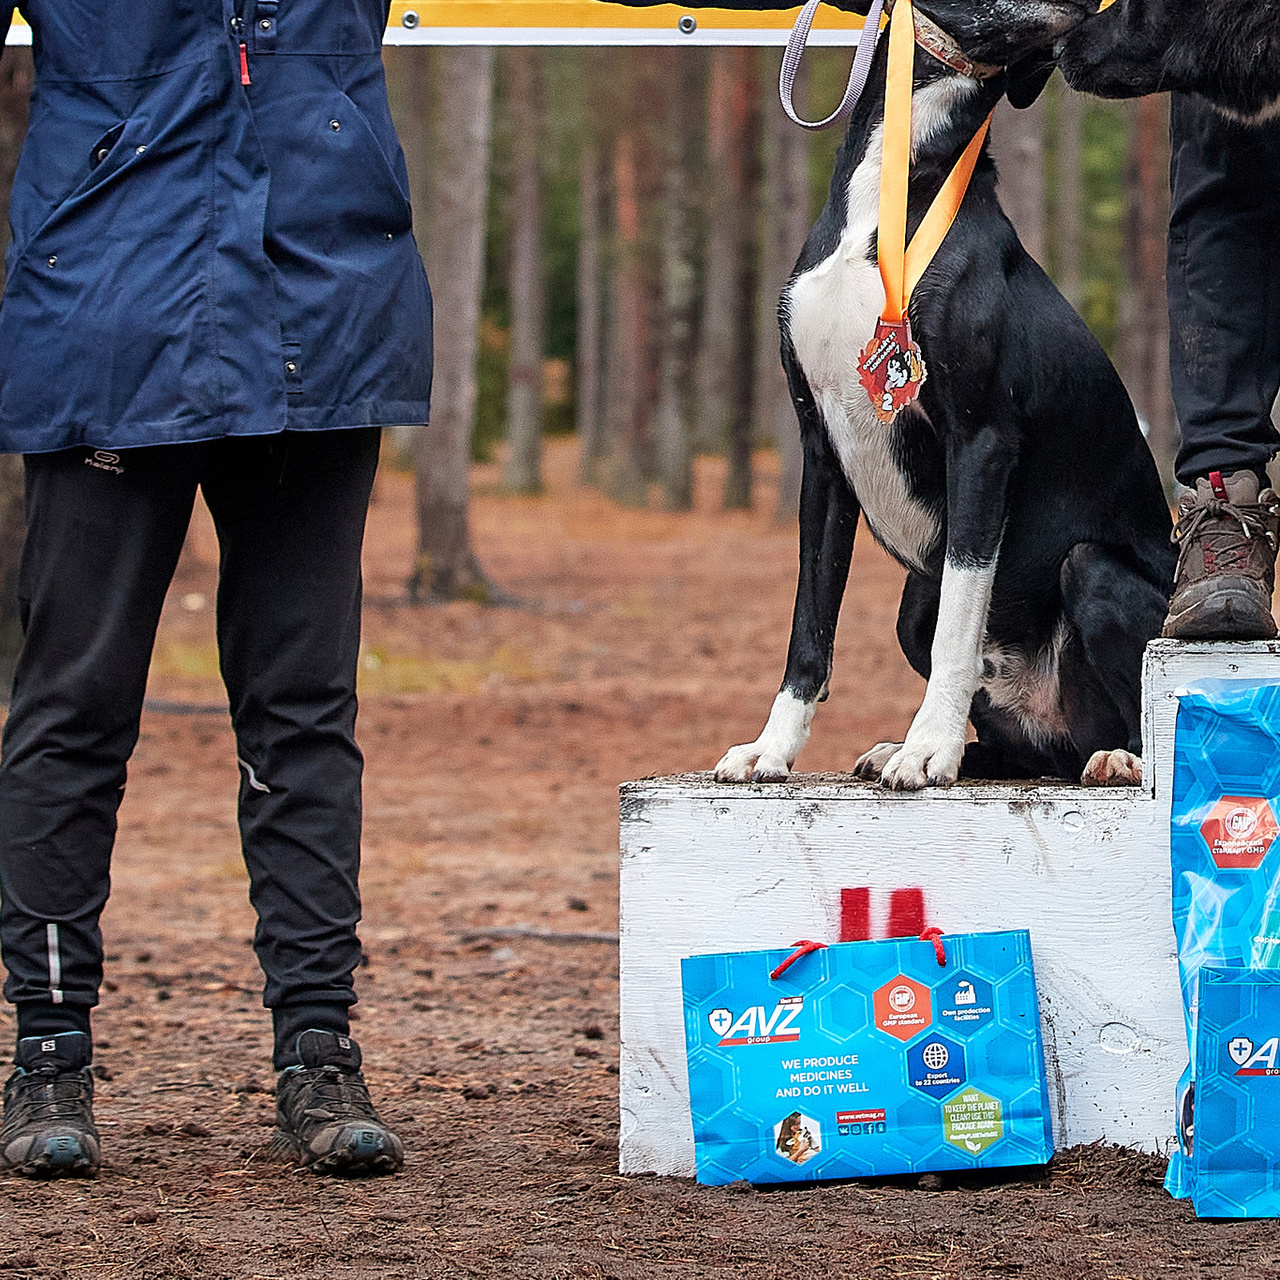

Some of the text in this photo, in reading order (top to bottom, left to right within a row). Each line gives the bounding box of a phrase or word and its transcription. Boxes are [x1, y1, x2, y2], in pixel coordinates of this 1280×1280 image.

[881, 393, 894, 411] 2
[957, 1007, 991, 1016] production
[722, 1003, 803, 1039] AVZ
[888, 1013, 918, 1021] European
[898, 1018, 925, 1026] standard
[746, 1035, 771, 1045] group
[781, 1054, 859, 1070] WE PRODUCE
[790, 1069, 853, 1083] MEDICINES
[926, 1072, 948, 1080] Export
[775, 1082, 869, 1098] AND DO IT WELL
[962, 1093, 979, 1103] WANT
[952, 1103, 967, 1113] KEEP
[966, 1102, 977, 1112] THE
[977, 1101, 999, 1111] PLANET
[838, 1112, 885, 1121] www.vetmag.ru
